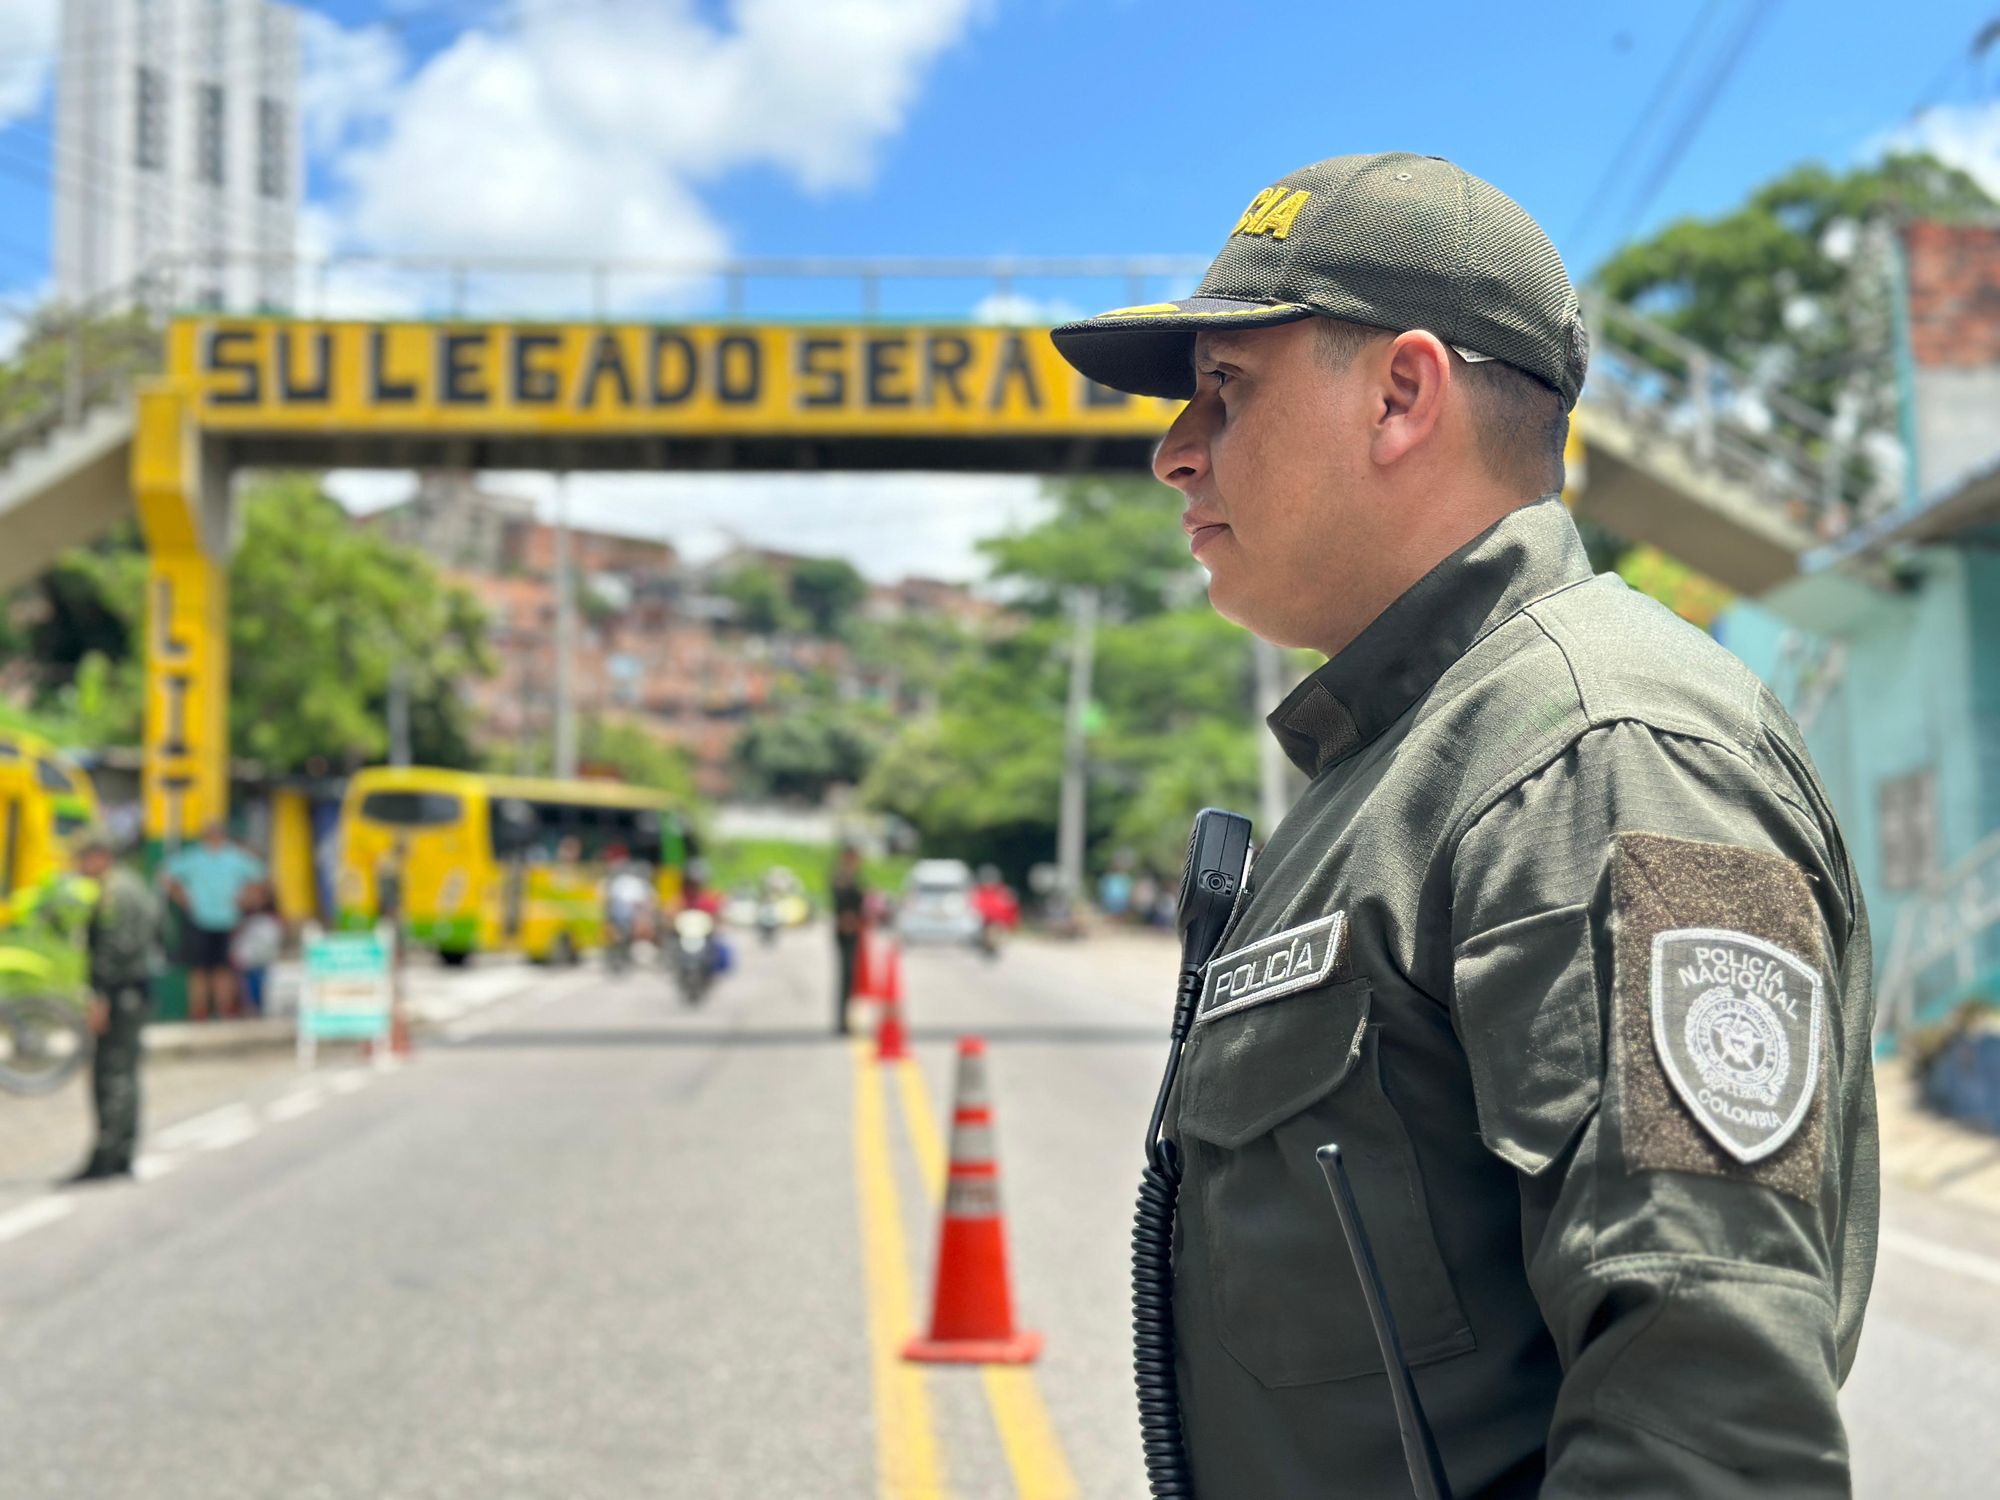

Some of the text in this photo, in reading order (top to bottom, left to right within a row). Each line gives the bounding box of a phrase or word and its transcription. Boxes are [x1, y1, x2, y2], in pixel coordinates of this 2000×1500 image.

[202, 331, 331, 404] SU
[367, 331, 761, 410] LEGADO
[1212, 938, 1312, 1005] POLICÍA
[1678, 966, 1798, 1020] NACIONAL
[1695, 947, 1784, 989] POLICÍA
[1698, 1088, 1784, 1128] COLOMBIA
